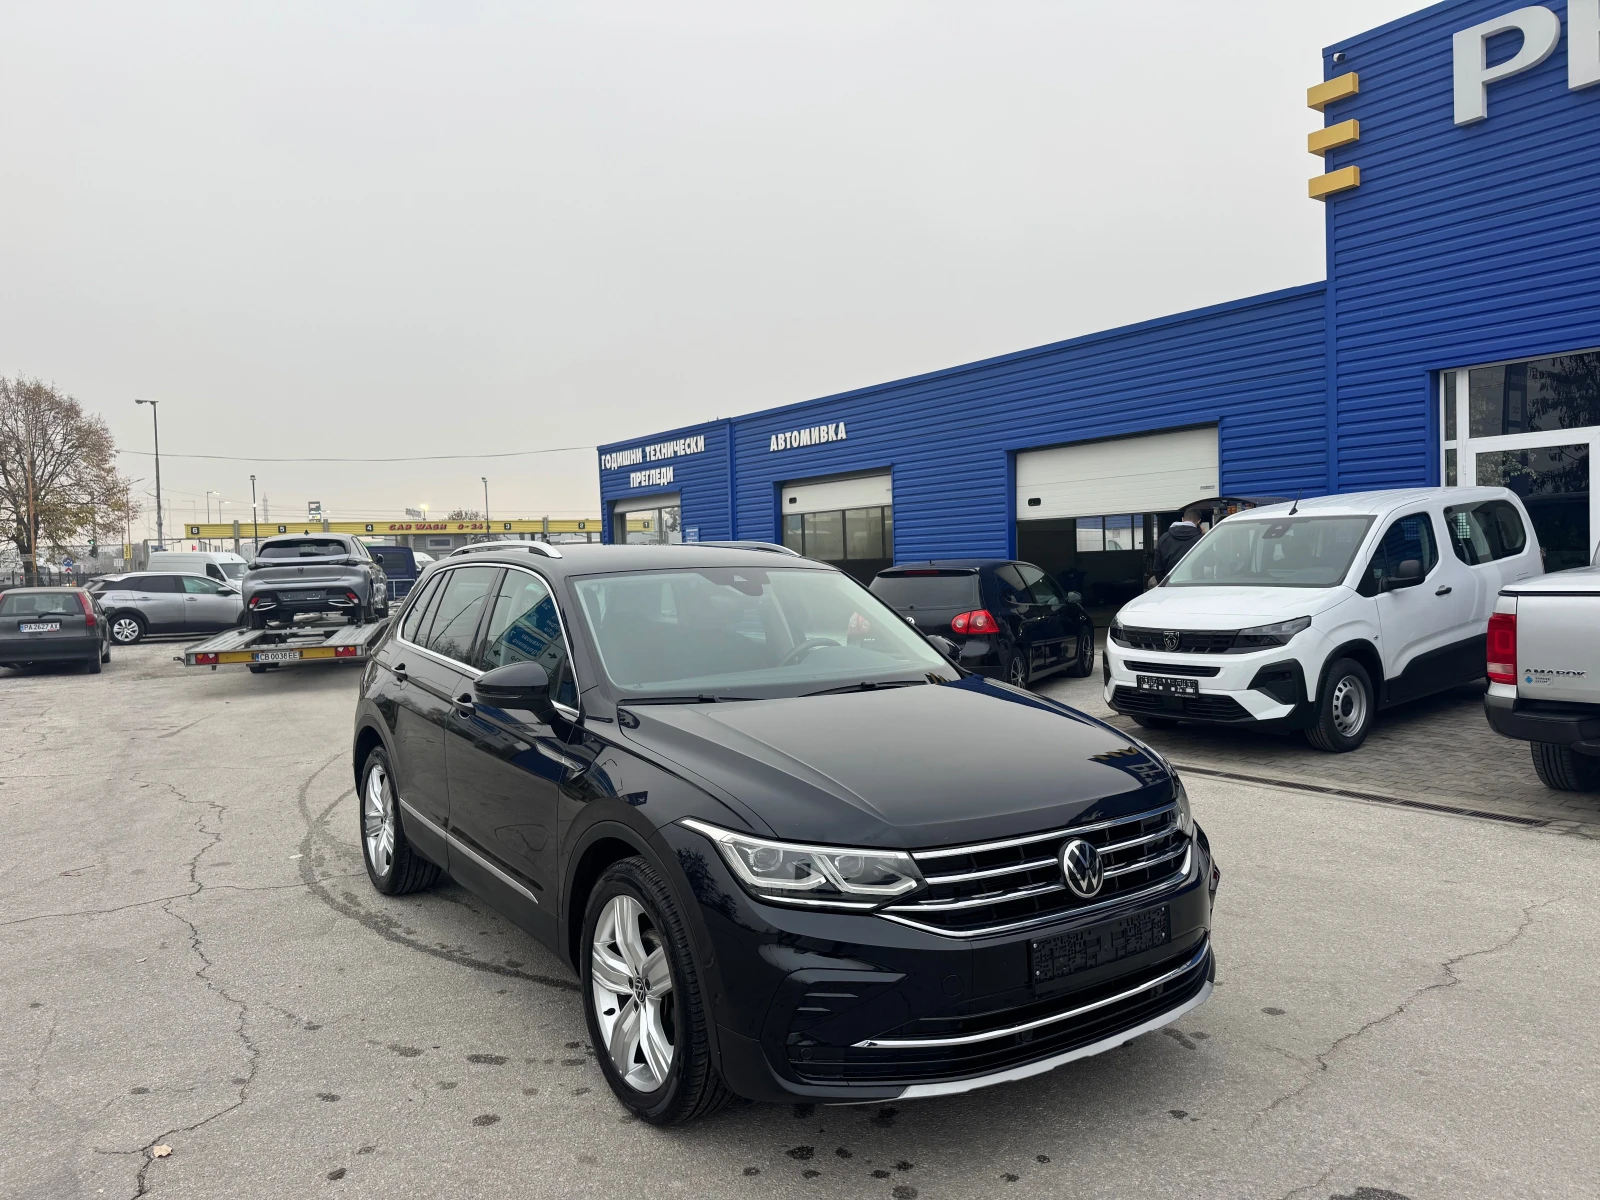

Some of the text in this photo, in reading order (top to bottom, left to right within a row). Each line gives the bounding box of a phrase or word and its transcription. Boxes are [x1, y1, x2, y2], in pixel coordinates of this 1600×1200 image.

[770, 421, 847, 452] АВТОМИВКА
[601, 435, 705, 470] ГОДИШНИ ТЕХНИЧЕСКИ
[630, 466, 674, 488] ПРЕГЛЕДИ
[389, 523, 412, 531] CAR
[415, 523, 447, 531] WASH
[260, 653, 270, 661] CB
[270, 652, 288, 660] 0038
[1525, 668, 1587, 678] AMAROK
